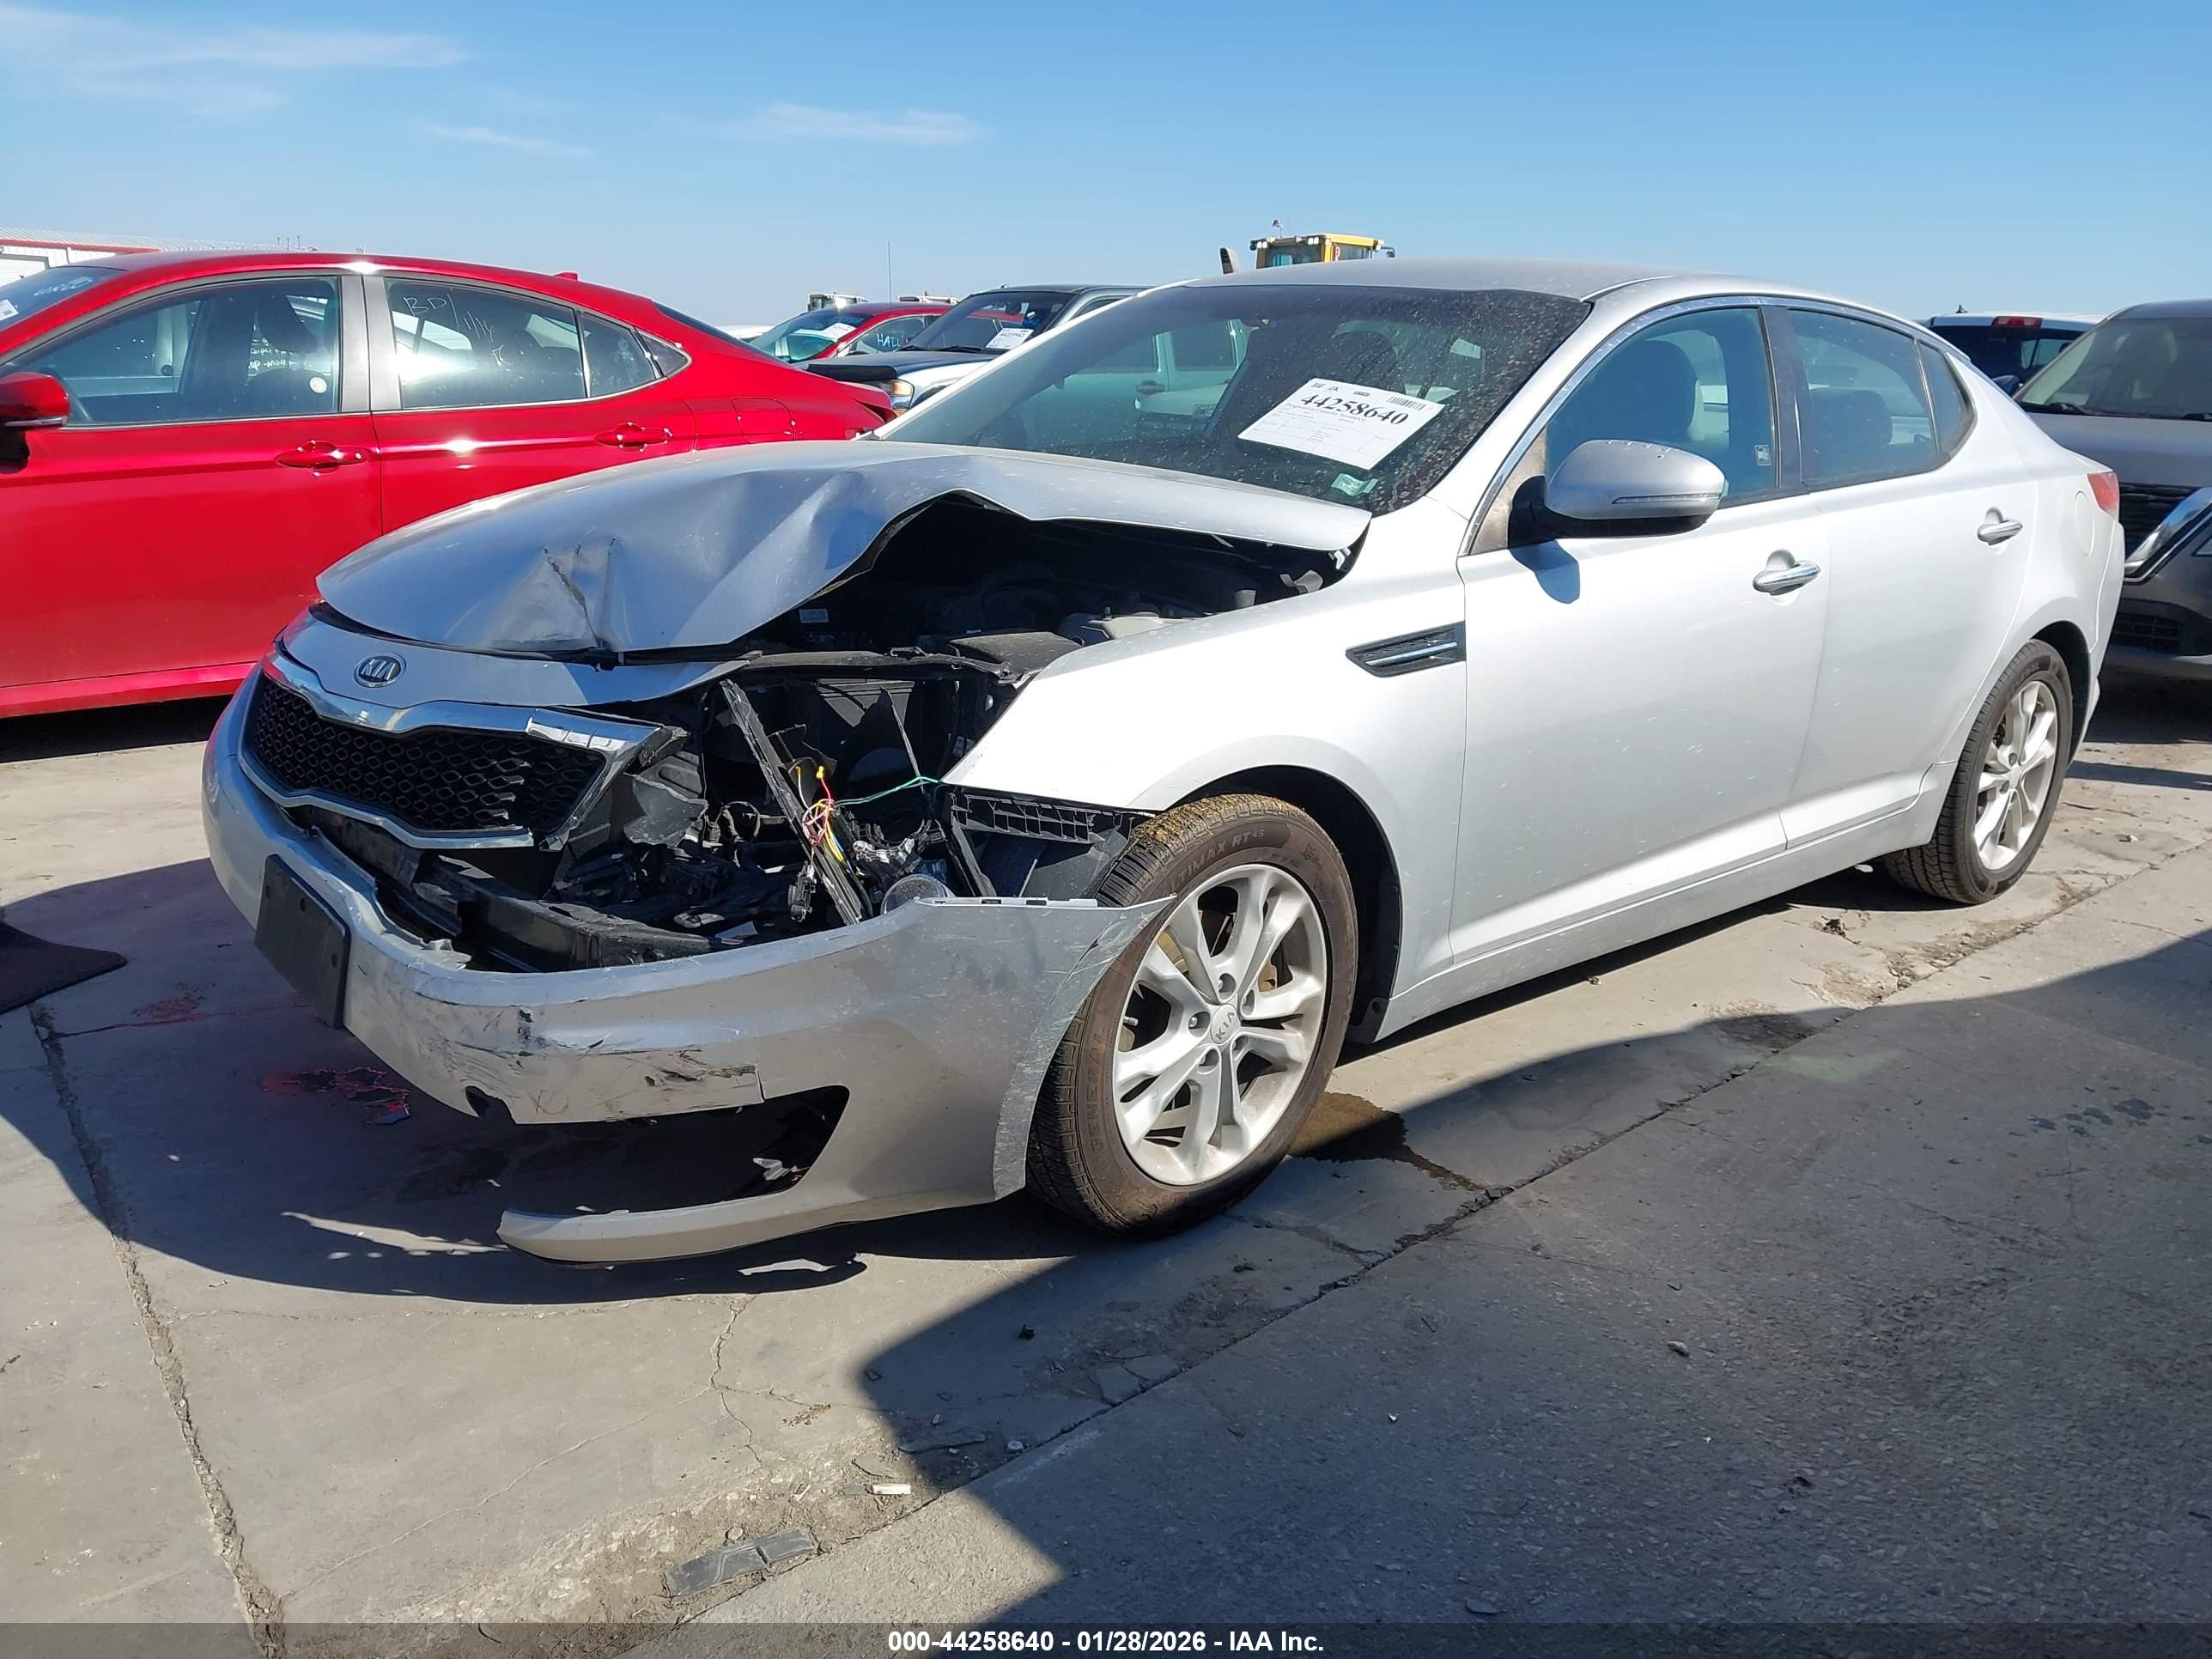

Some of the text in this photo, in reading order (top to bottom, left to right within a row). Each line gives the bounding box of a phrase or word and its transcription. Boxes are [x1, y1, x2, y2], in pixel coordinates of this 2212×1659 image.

[1301, 394, 1409, 424] 44258640
[361, 659, 396, 681] KIA
[1215, 1012, 1235, 1041] KIA
